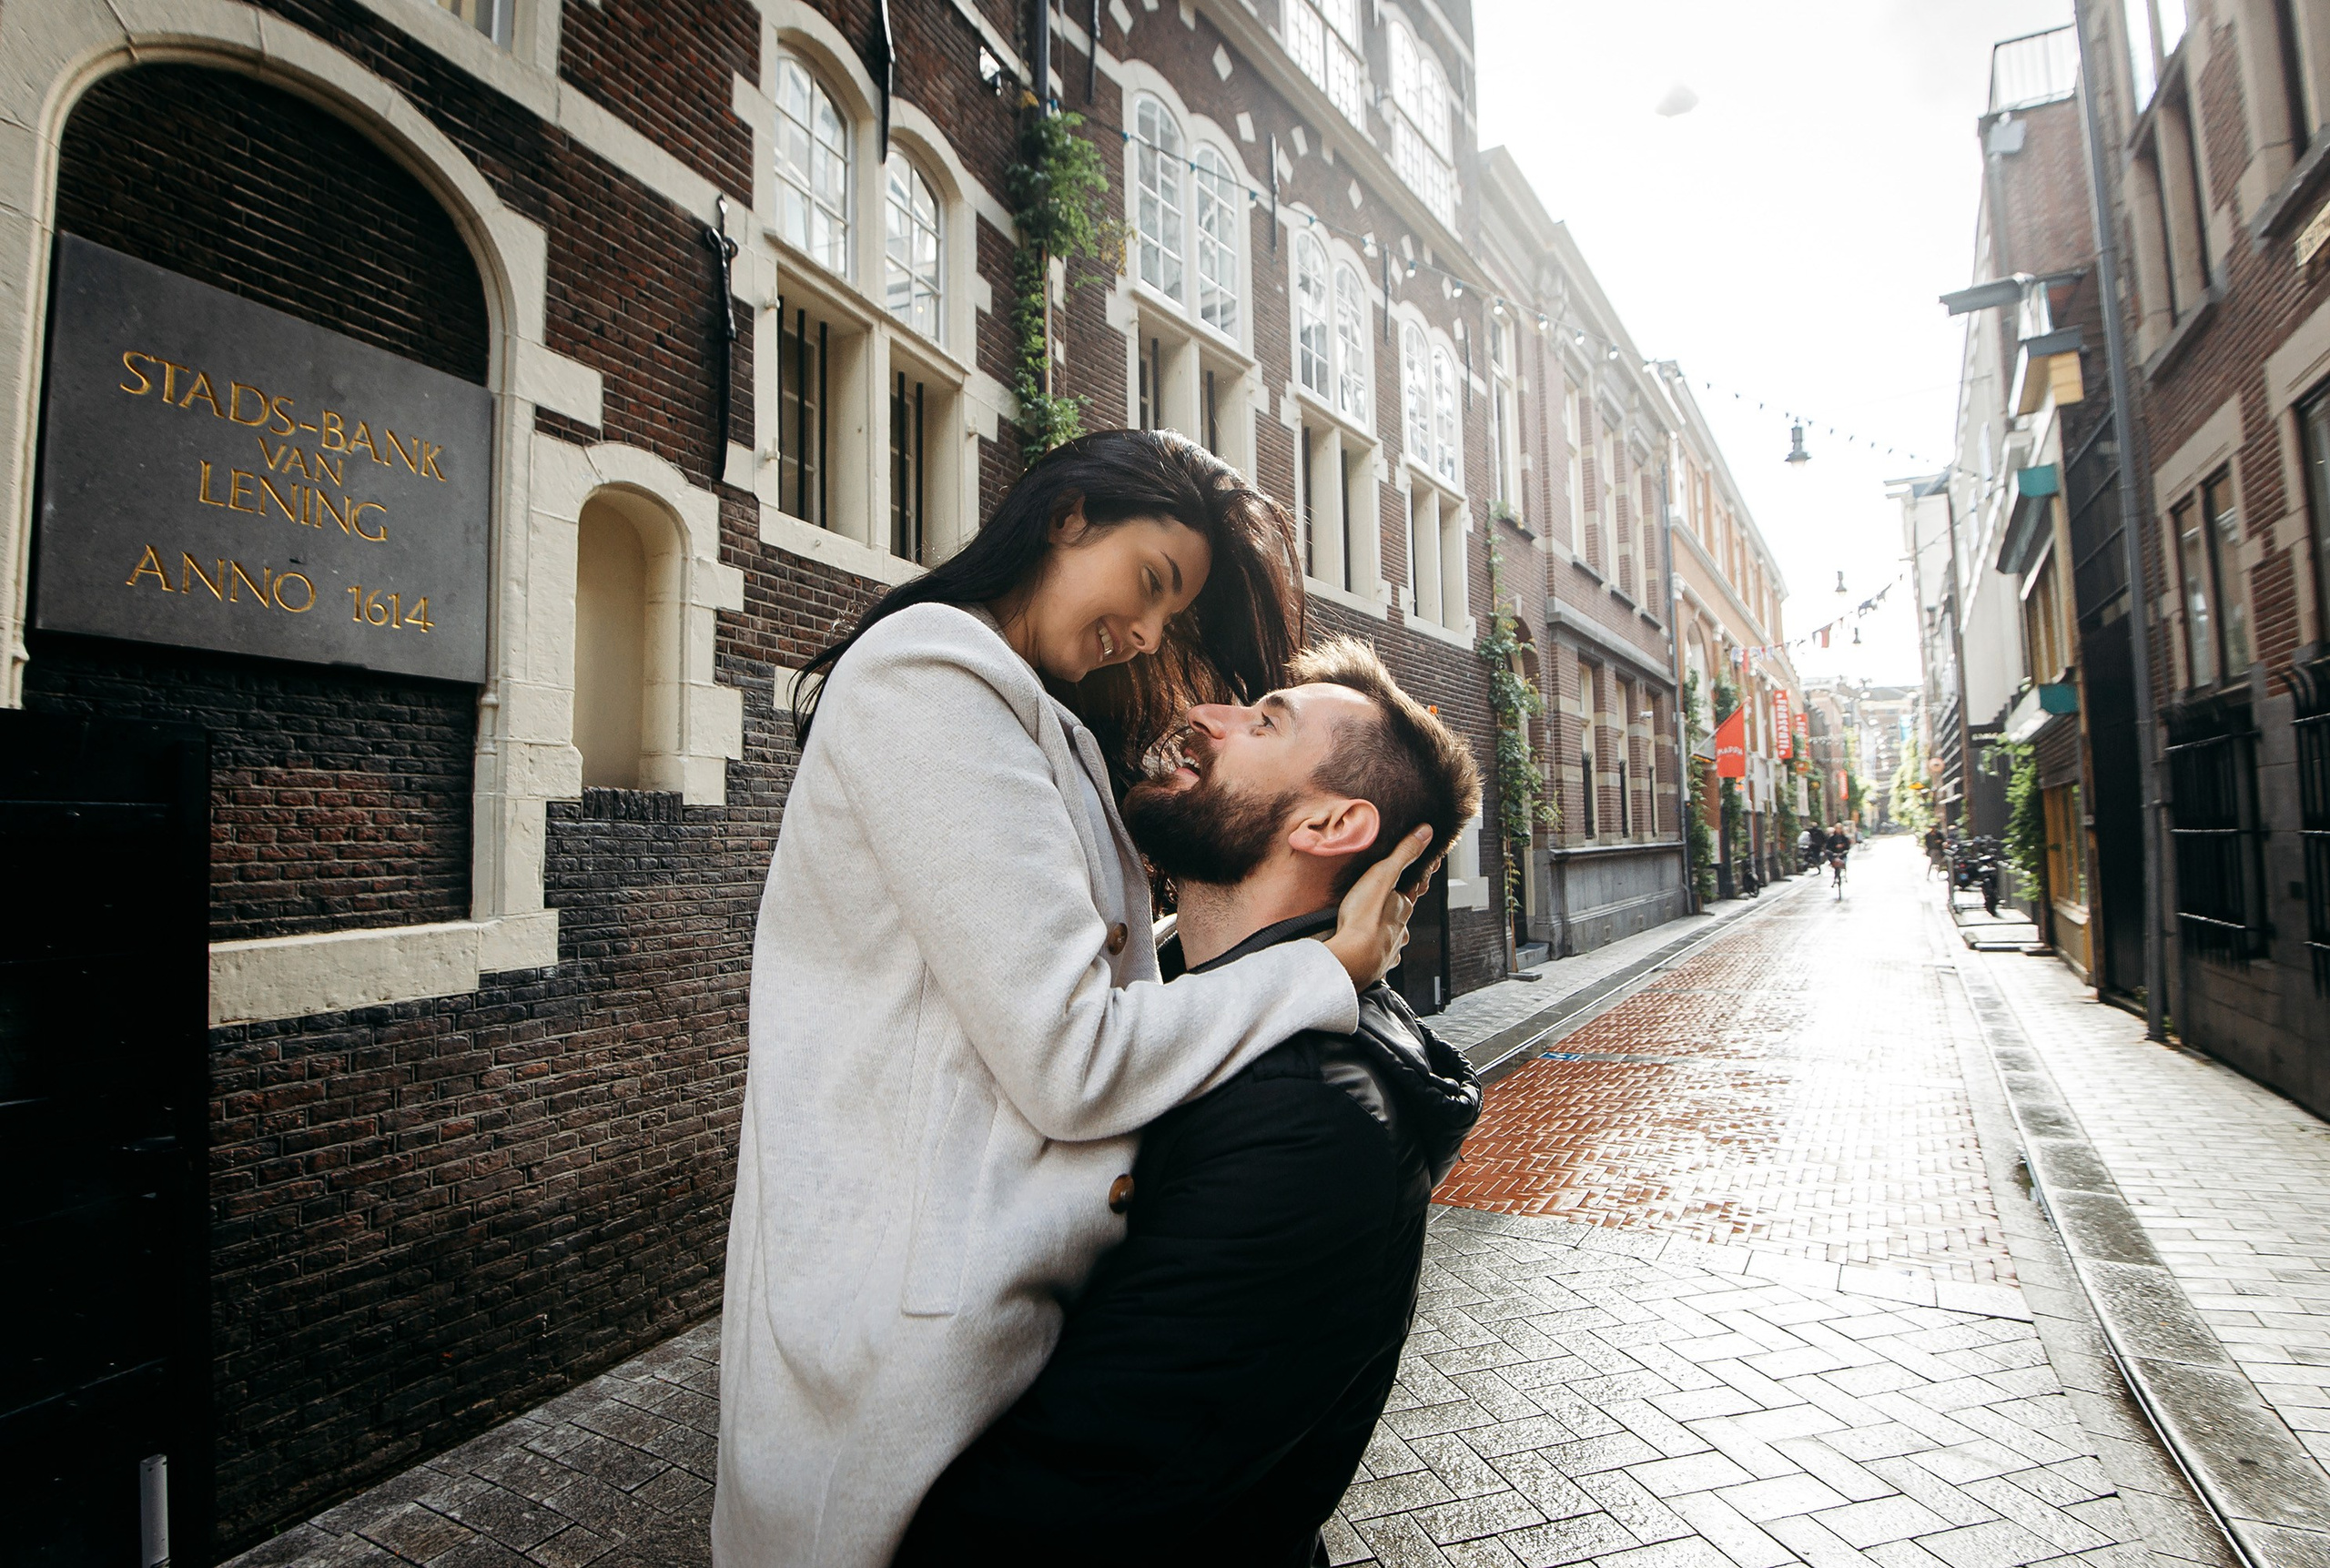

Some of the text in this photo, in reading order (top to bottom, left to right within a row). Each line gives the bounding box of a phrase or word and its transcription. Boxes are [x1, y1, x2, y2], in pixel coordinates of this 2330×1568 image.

[119, 350, 447, 482] STADS-BANK
[198, 460, 389, 541] LENING
[258, 437, 343, 487] VAN
[126, 544, 436, 633] ANNO 1614
